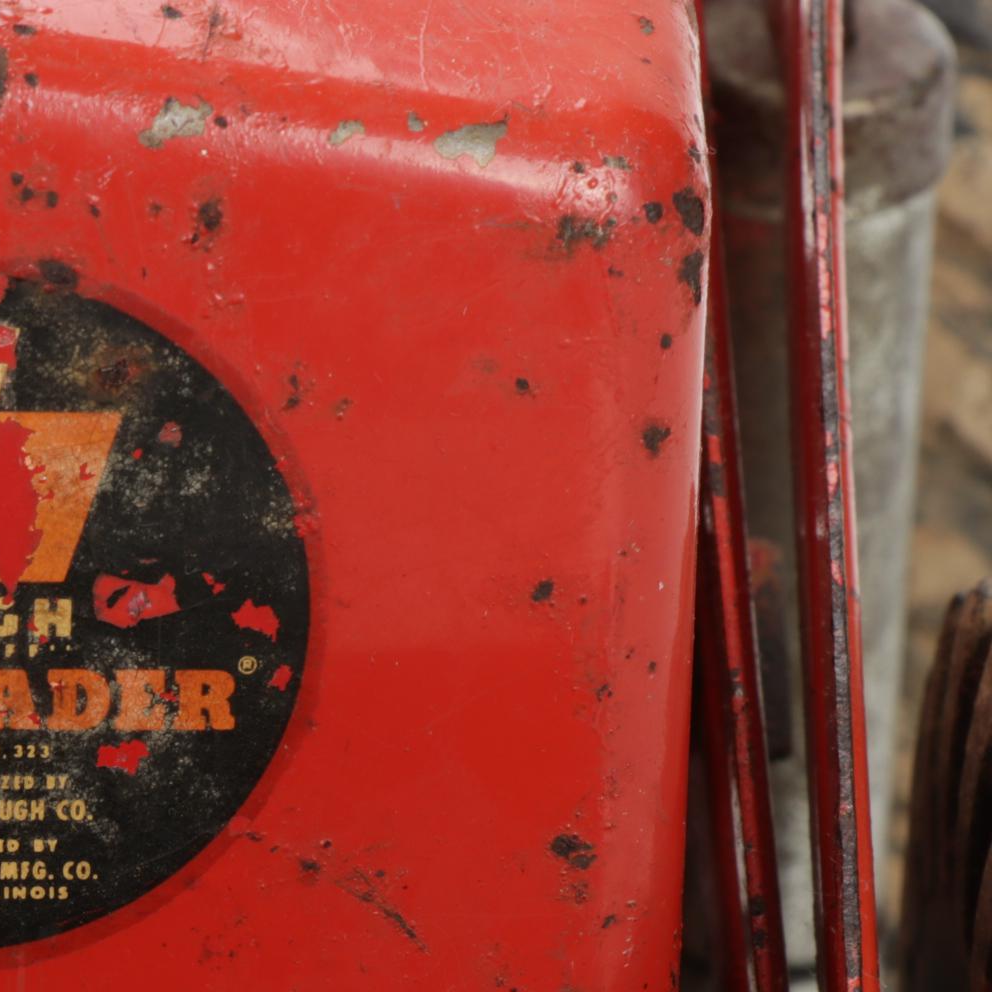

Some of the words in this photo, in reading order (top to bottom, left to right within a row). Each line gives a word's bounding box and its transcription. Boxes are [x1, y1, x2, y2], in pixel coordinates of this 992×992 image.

[46, 774, 69, 790] BY
[55, 799, 94, 821] CO.
[33, 837, 58, 853] BY
[0, 861, 55, 881] MFG.
[62, 860, 98, 881] CO.
